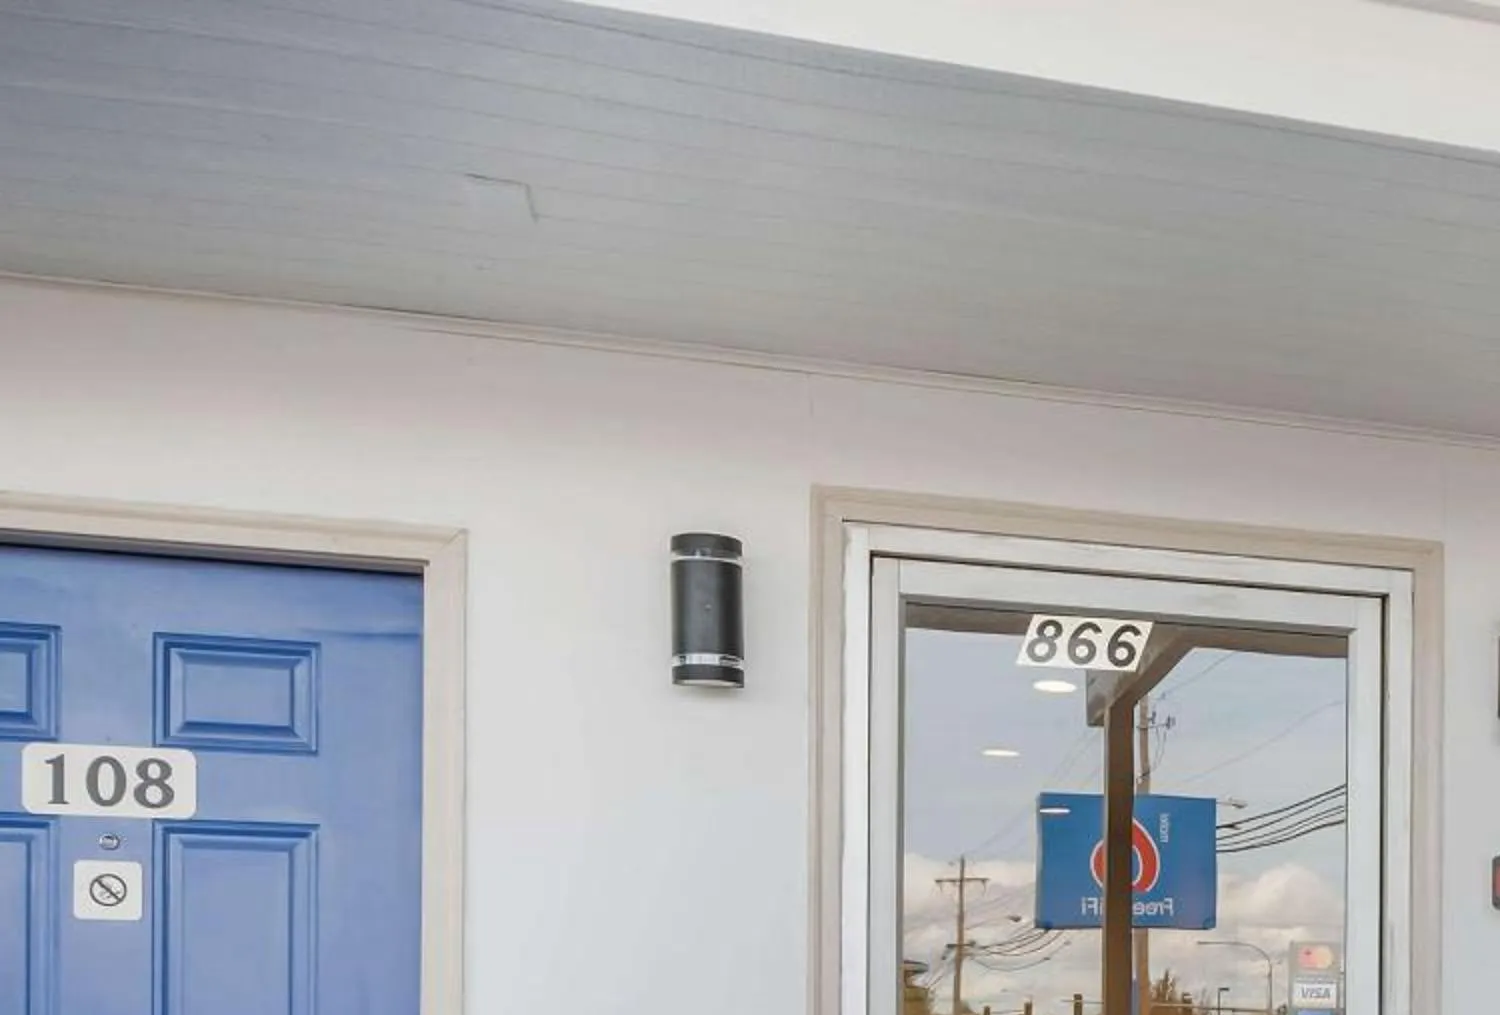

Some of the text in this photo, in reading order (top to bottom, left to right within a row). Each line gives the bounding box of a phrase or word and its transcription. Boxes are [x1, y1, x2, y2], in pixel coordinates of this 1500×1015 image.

[1026, 619, 1142, 668] 866
[45, 753, 175, 809] 108
[1301, 986, 1331, 999] VISA
